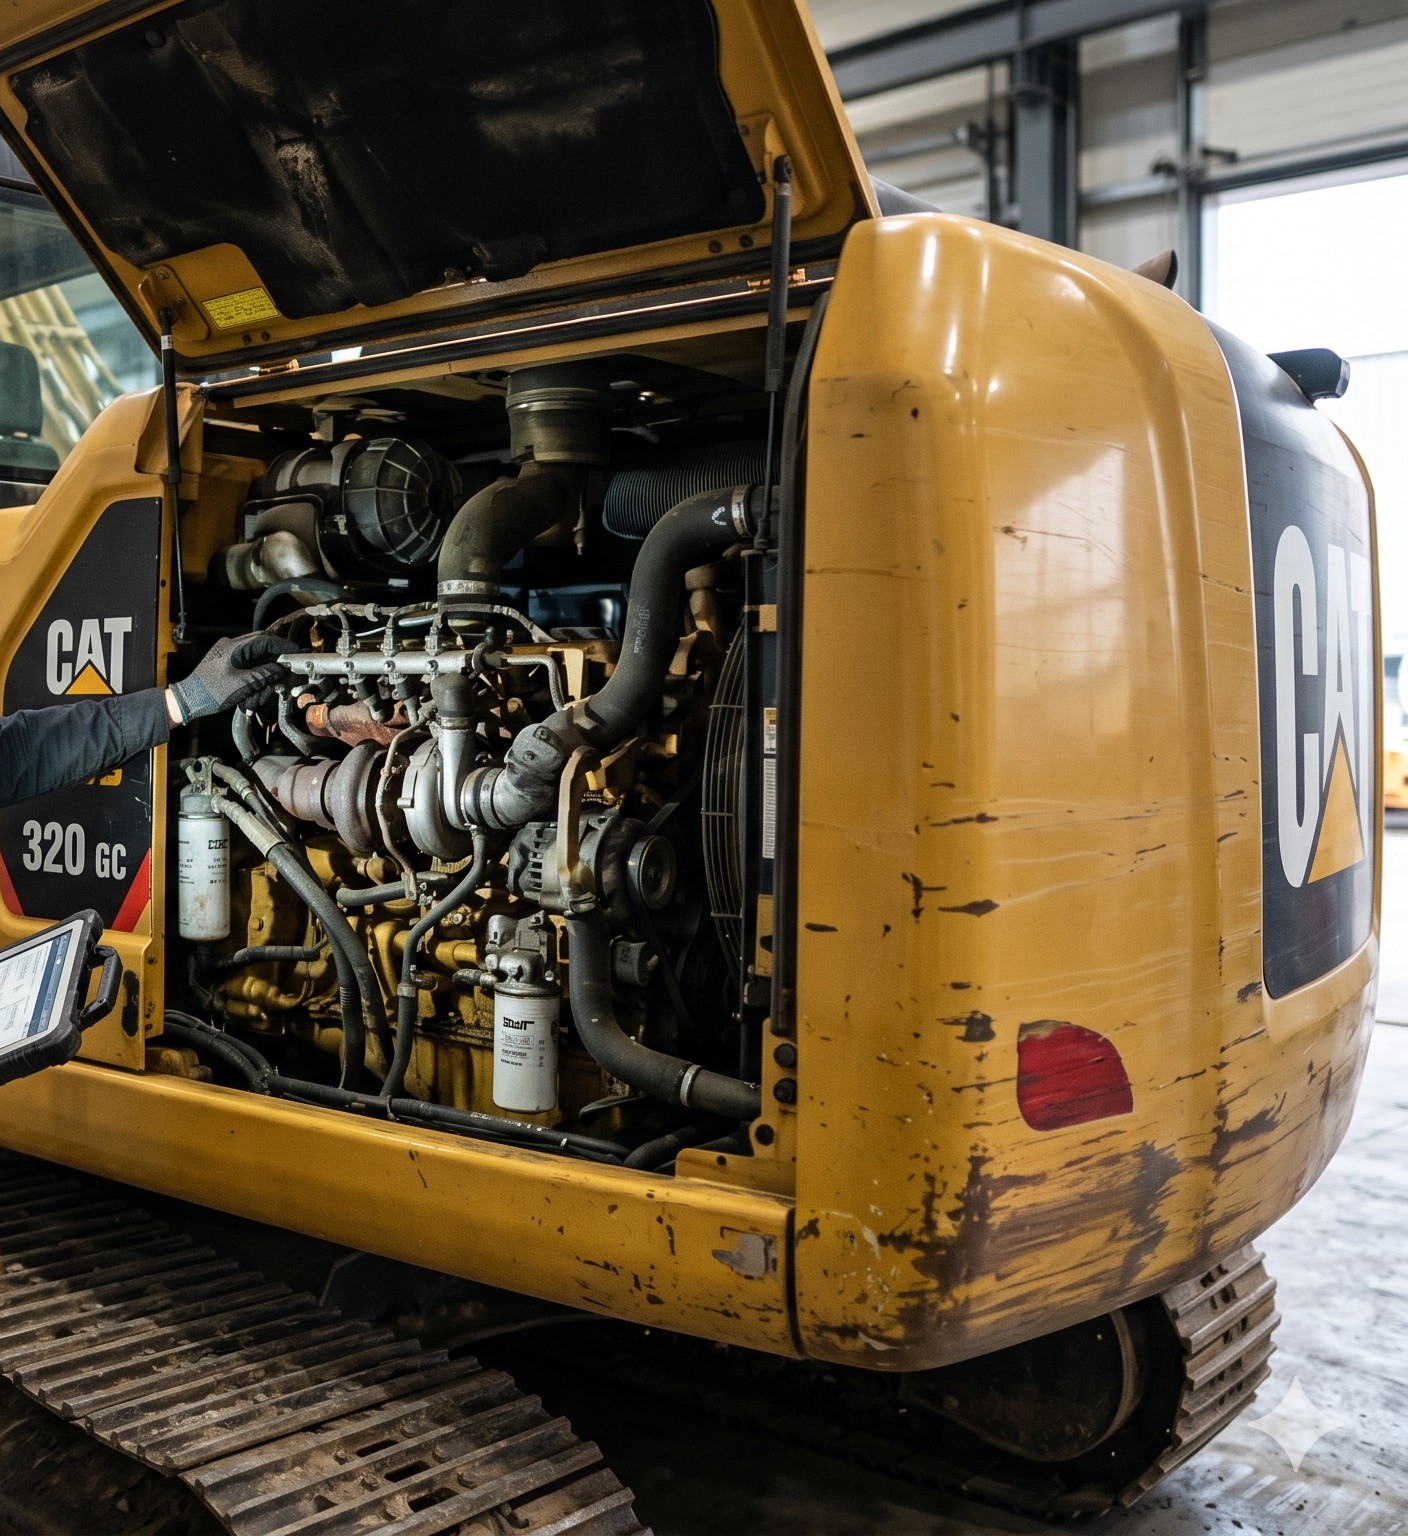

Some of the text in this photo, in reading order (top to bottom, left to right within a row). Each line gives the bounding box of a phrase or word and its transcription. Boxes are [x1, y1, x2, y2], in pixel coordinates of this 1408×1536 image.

[46, 617, 133, 696] CAT
[1274, 525, 1371, 887] CAT
[22, 819, 86, 876] 320
[95, 842, 127, 880] GC
